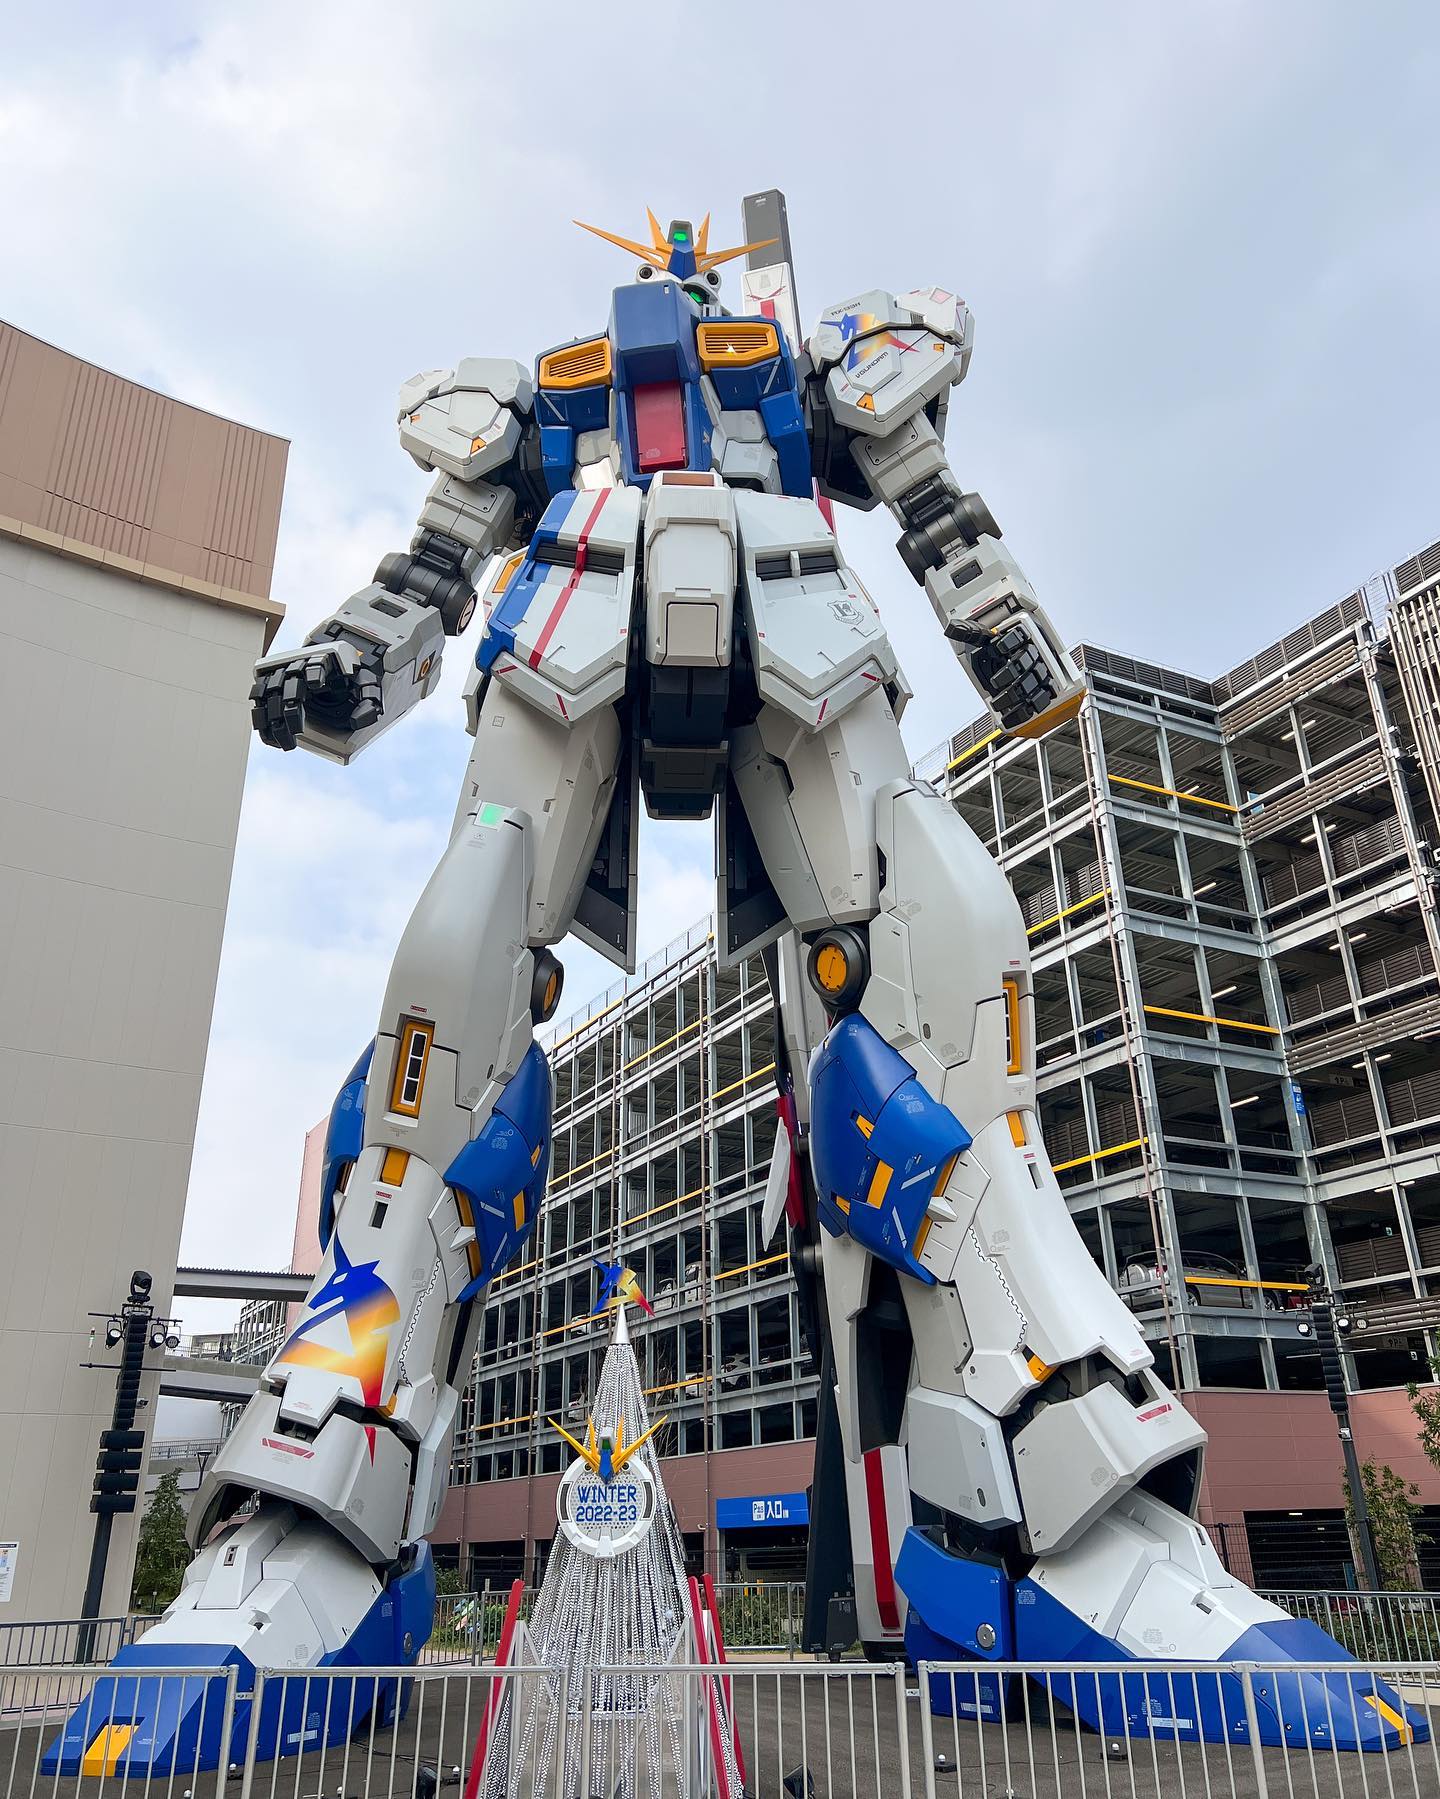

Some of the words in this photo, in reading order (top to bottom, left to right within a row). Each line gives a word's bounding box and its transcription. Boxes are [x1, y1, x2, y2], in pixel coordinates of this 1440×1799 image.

[578, 1484, 636, 1503] WINTER
[576, 1505, 637, 1522] 2022-23
[766, 1500, 782, 1519] 入口
